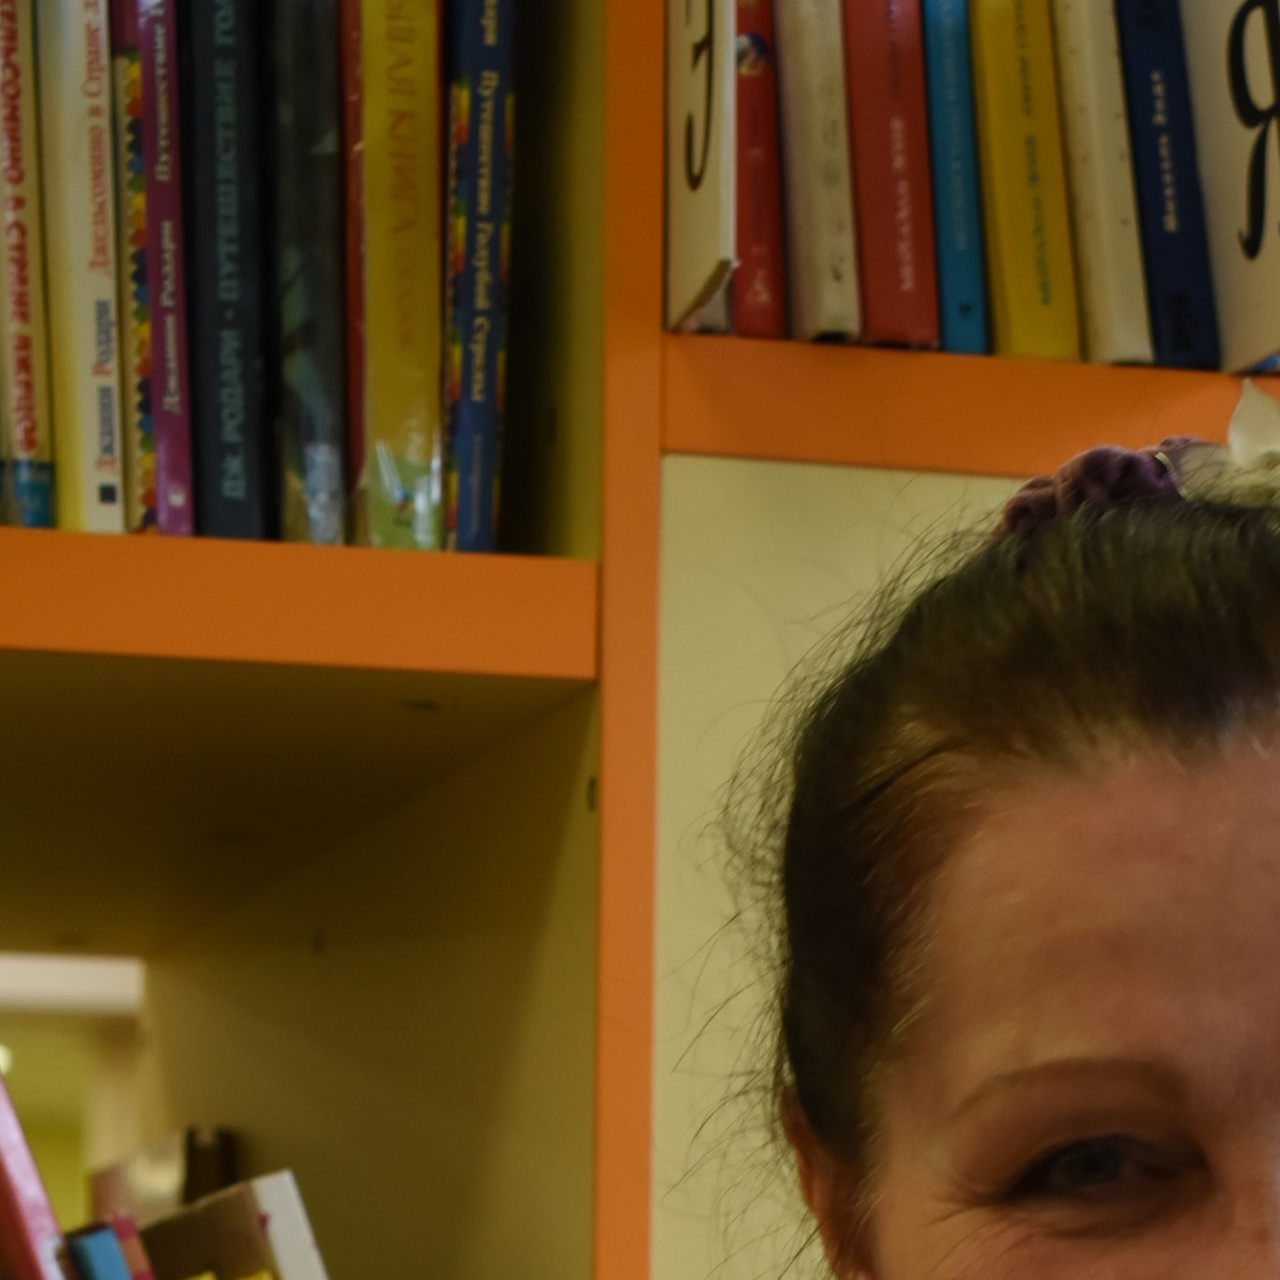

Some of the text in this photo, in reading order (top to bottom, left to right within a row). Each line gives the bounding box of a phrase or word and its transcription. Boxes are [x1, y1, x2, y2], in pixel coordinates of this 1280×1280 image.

[214, 59, 241, 303] ПУТЕШЕСТВИЕ
[386, 109, 421, 235] КНИГА
[477, 69, 499, 216] Путешествие
[157, 220, 178, 309] Родари
[471, 221, 495, 311] Голубой
[220, 330, 246, 443] РОДАРИ
[468, 317, 490, 402] Стрелы
